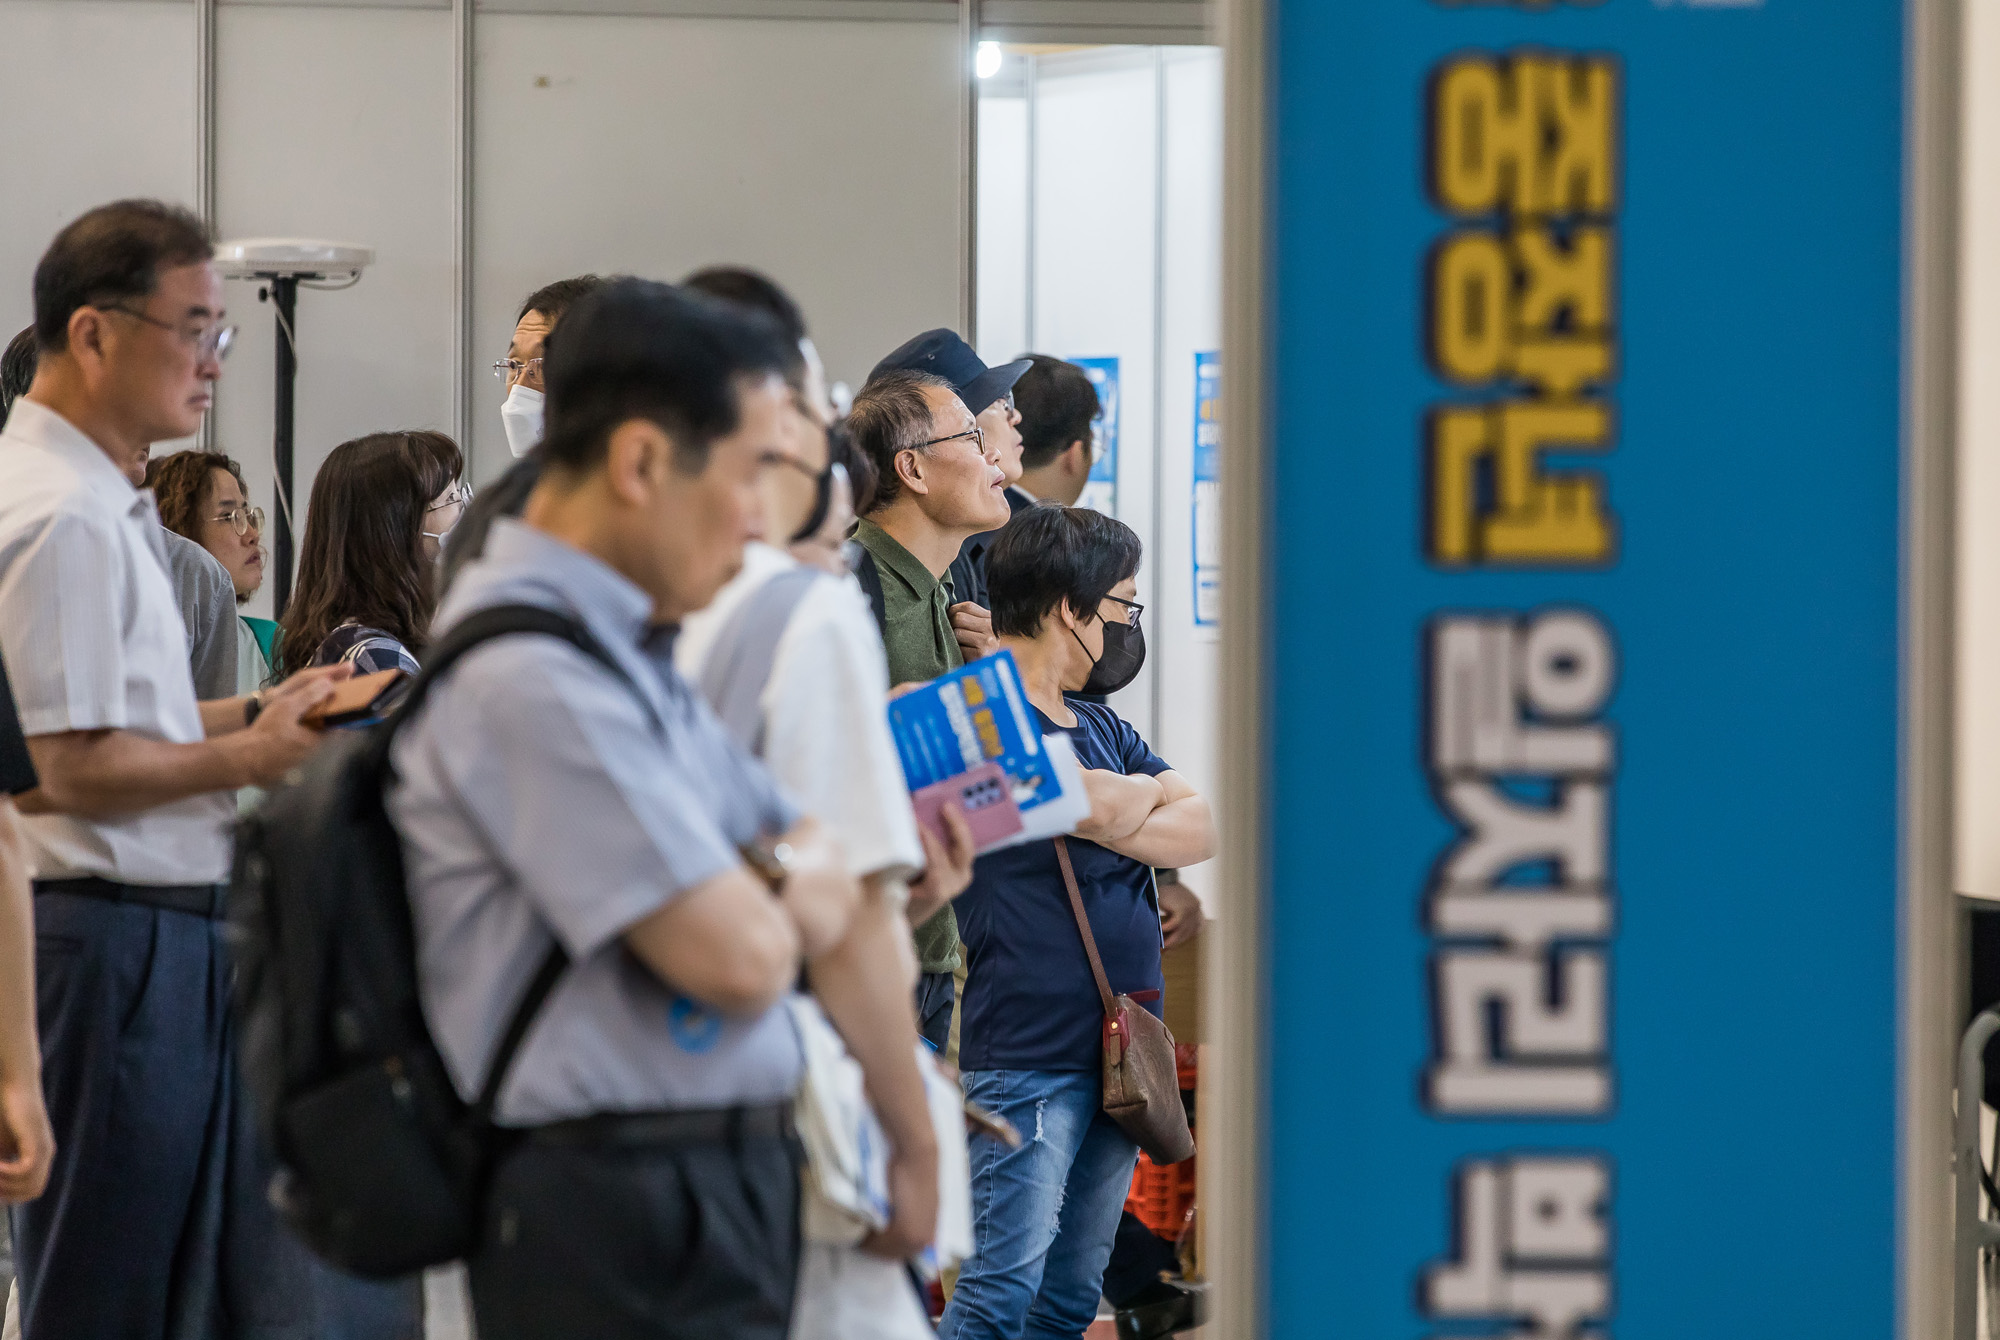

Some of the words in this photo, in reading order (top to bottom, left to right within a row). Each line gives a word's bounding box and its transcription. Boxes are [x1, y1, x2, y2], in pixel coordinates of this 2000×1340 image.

[1430, 55, 1619, 565] 중장년
[1430, 609, 1617, 1115] 일자리
[1427, 1157, 1614, 1340] 박
